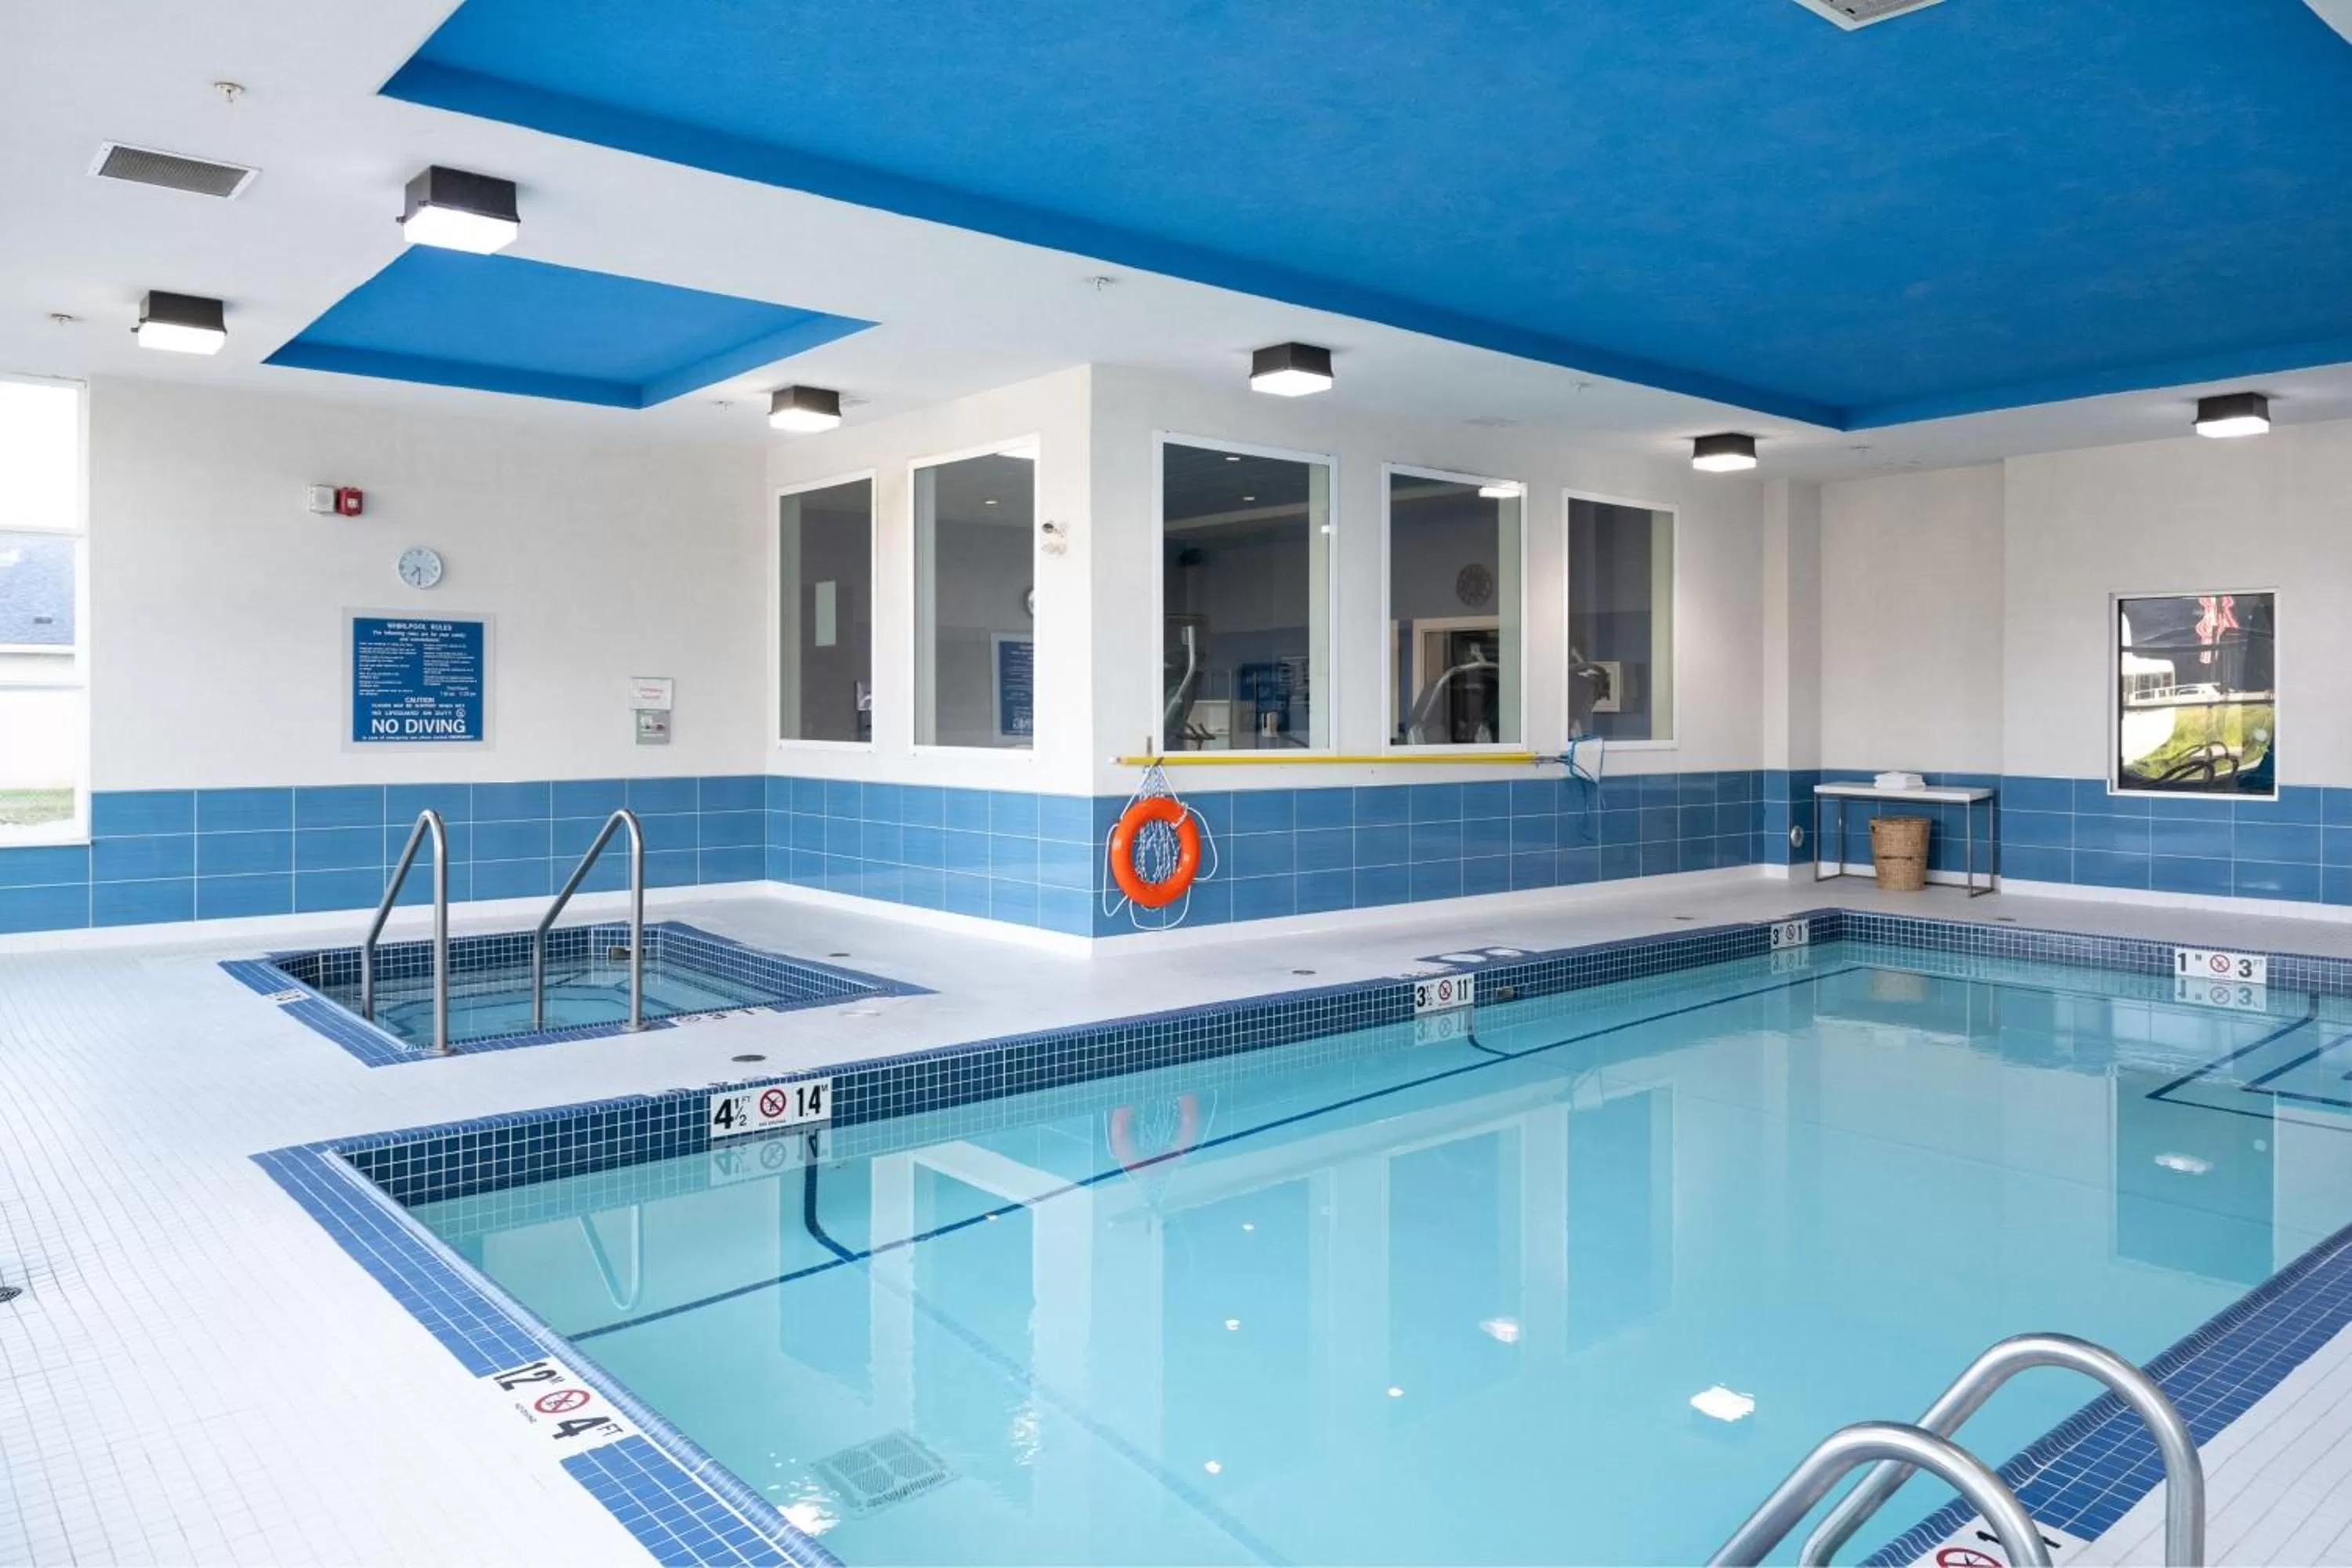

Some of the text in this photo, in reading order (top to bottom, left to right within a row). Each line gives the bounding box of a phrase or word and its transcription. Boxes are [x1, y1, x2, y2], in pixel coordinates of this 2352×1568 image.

[372, 719, 466, 734] NO DIVING
[1773, 928, 1779, 945] 3
[2178, 953, 2187, 971] 1
[2238, 959, 2252, 978] 3
[1417, 985, 1426, 1007] 3
[713, 1098, 734, 1129] 4
[552, 1415, 612, 1439] 4
